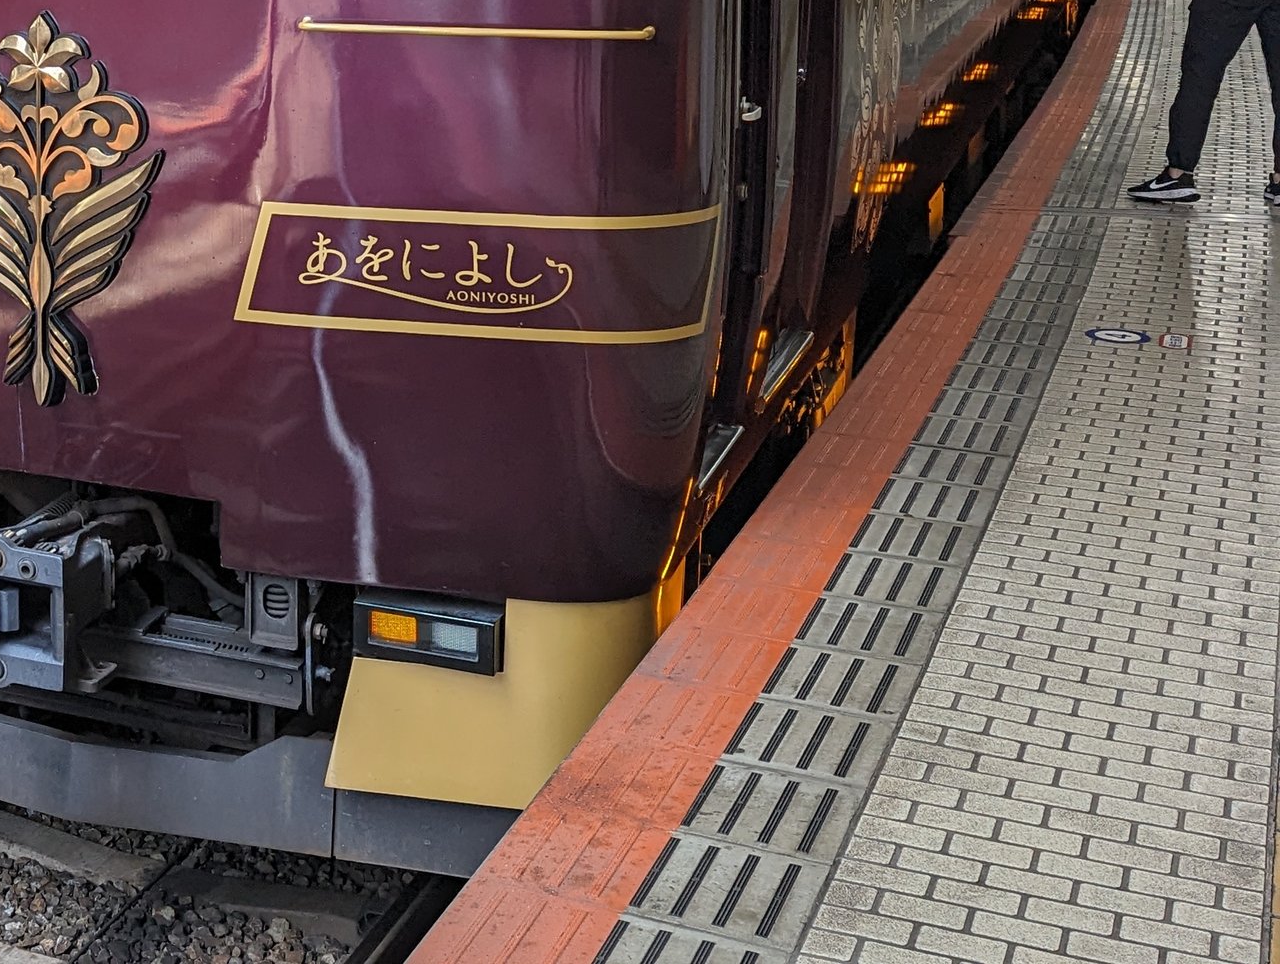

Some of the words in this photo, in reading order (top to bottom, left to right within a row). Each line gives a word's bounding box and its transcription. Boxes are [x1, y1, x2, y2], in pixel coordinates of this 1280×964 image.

[298, 232, 542, 288] あをによし
[446, 290, 536, 305] AONIYOSHI
